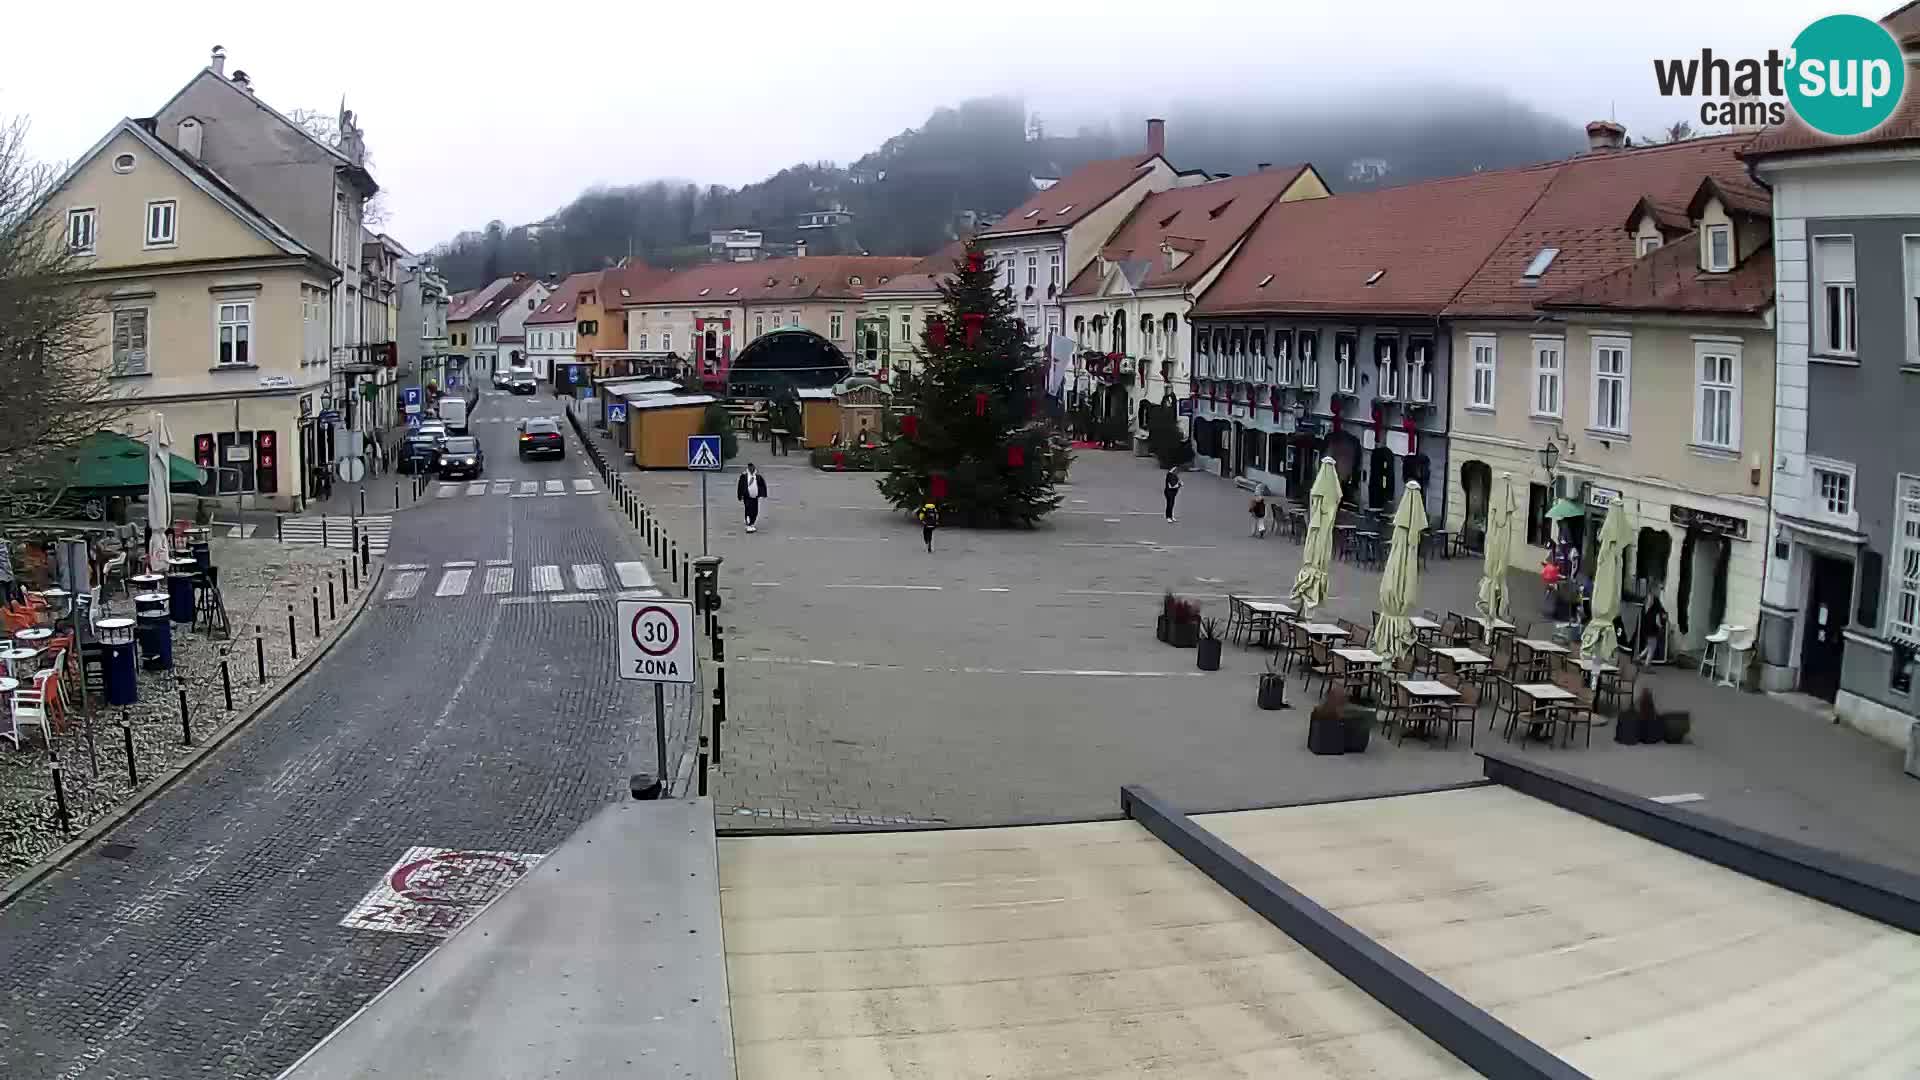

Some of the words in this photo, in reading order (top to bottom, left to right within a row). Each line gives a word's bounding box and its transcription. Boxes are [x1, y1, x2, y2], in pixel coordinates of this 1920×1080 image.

[409, 391, 416, 402] P
[644, 621, 668, 643] 30
[634, 659, 678, 675] ZONA
